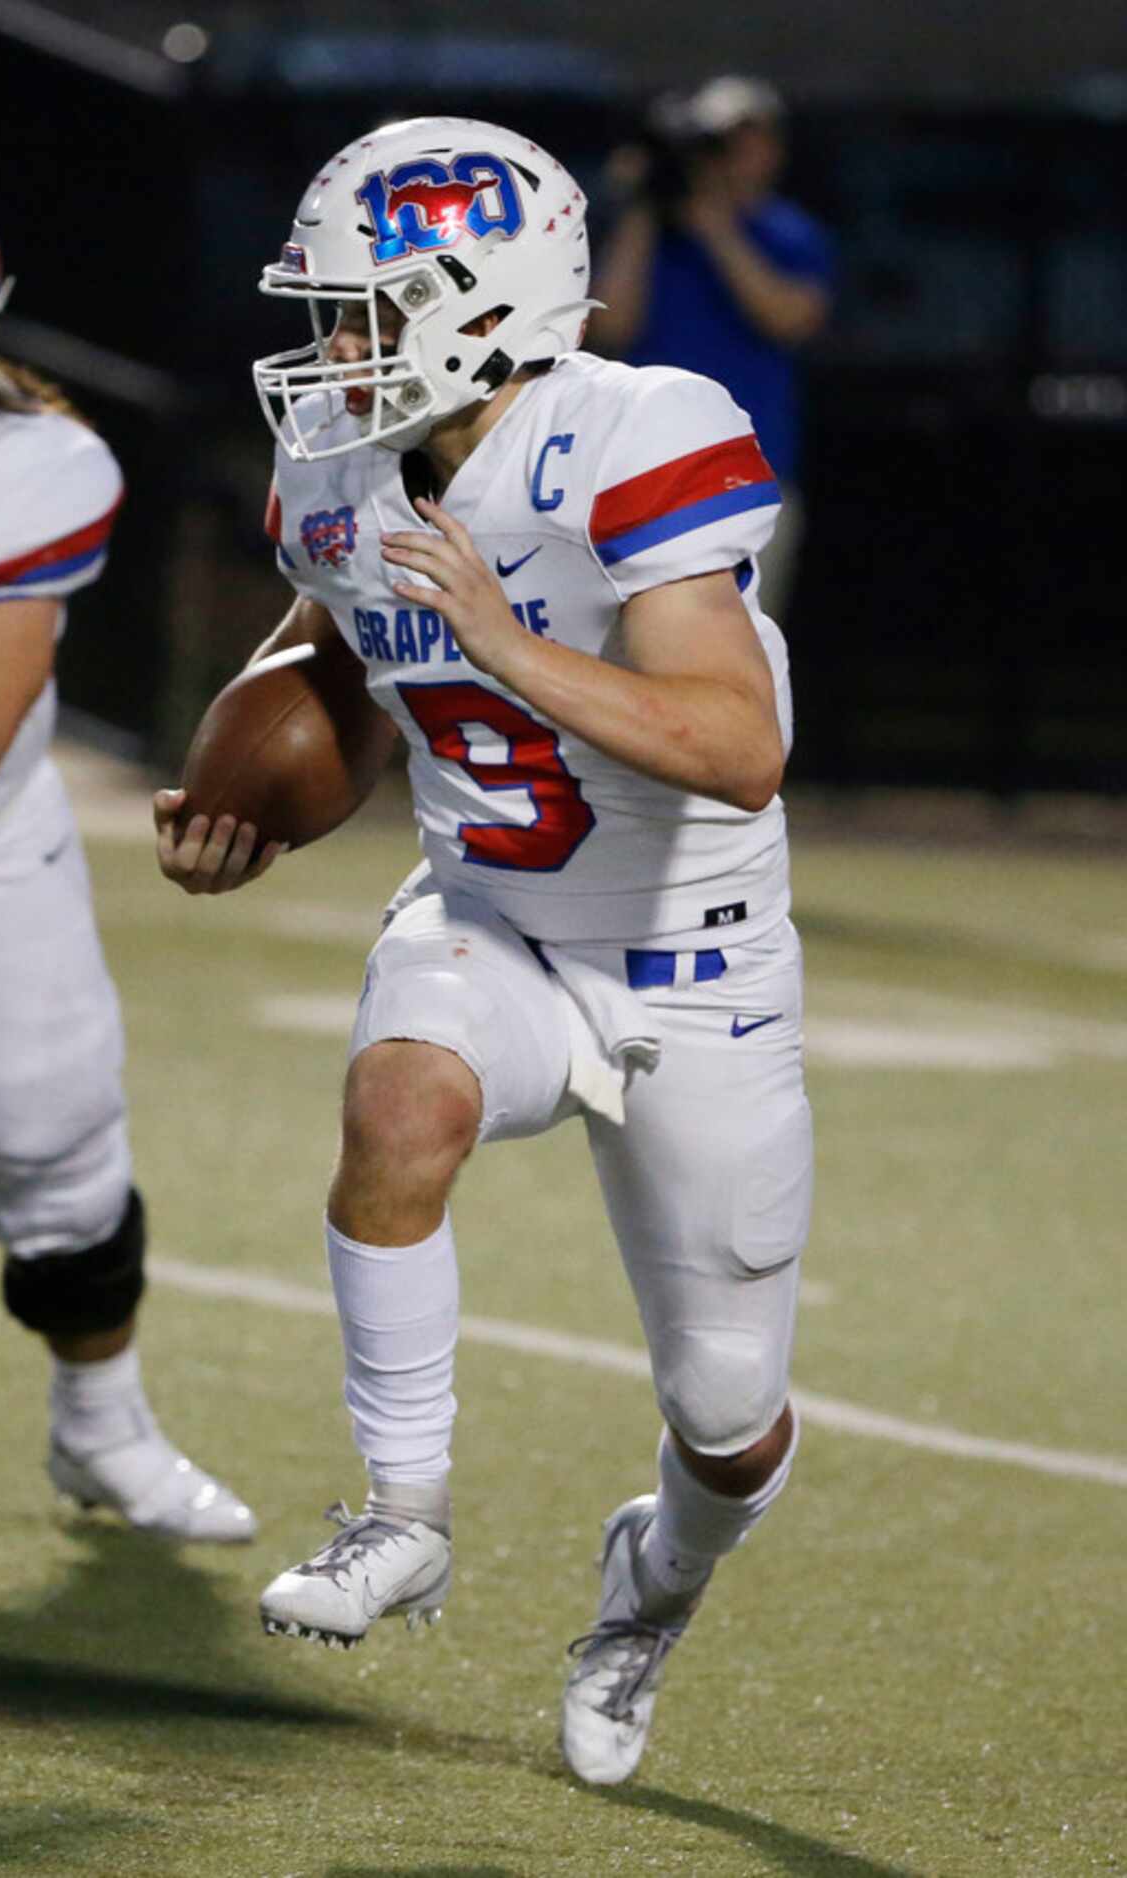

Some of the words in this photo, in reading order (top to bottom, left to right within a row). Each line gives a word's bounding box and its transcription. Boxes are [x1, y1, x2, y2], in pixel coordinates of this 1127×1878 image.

[530, 433, 575, 513] C
[353, 597, 557, 664] GRAPE
[394, 680, 597, 873] 9
[717, 909, 735, 924] M
